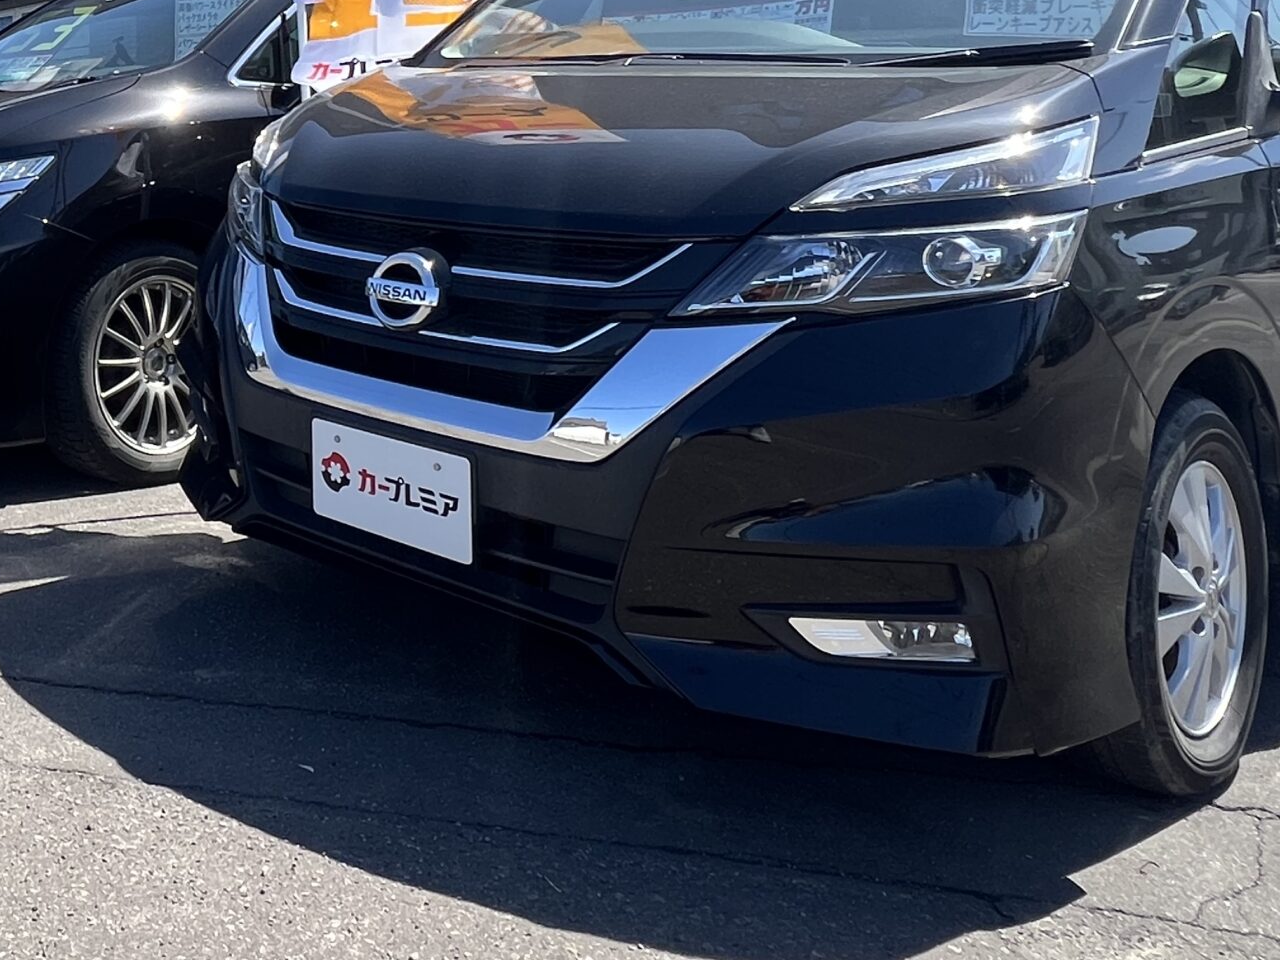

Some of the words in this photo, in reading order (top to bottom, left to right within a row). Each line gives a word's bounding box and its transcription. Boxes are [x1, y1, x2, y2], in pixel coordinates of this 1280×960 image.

[370, 282, 427, 302] NISSAN
[358, 468, 459, 518] カープレミア
